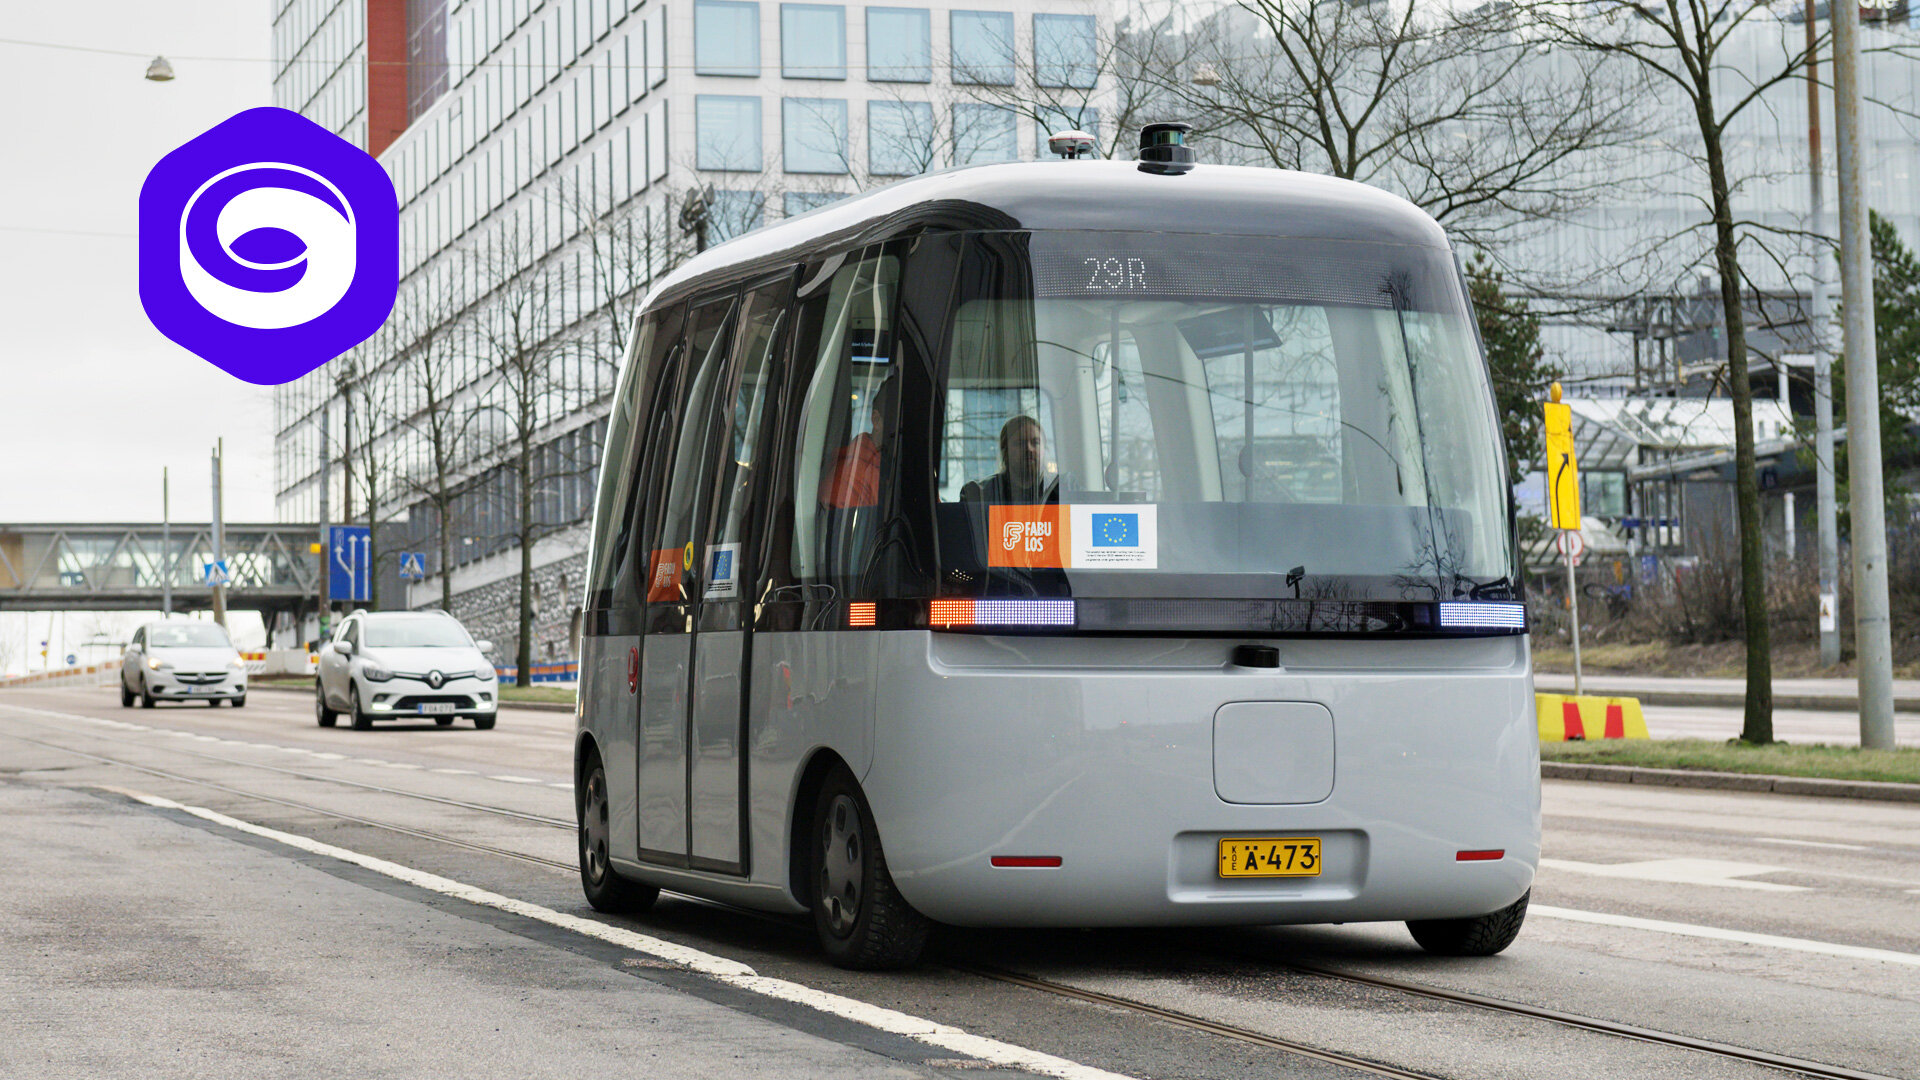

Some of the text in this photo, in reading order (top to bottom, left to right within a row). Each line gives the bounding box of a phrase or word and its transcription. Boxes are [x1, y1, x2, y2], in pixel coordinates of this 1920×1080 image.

[1084, 257, 1146, 289] 29R
[1025, 521, 1052, 537] FABU
[1024, 536, 1044, 552] LOS
